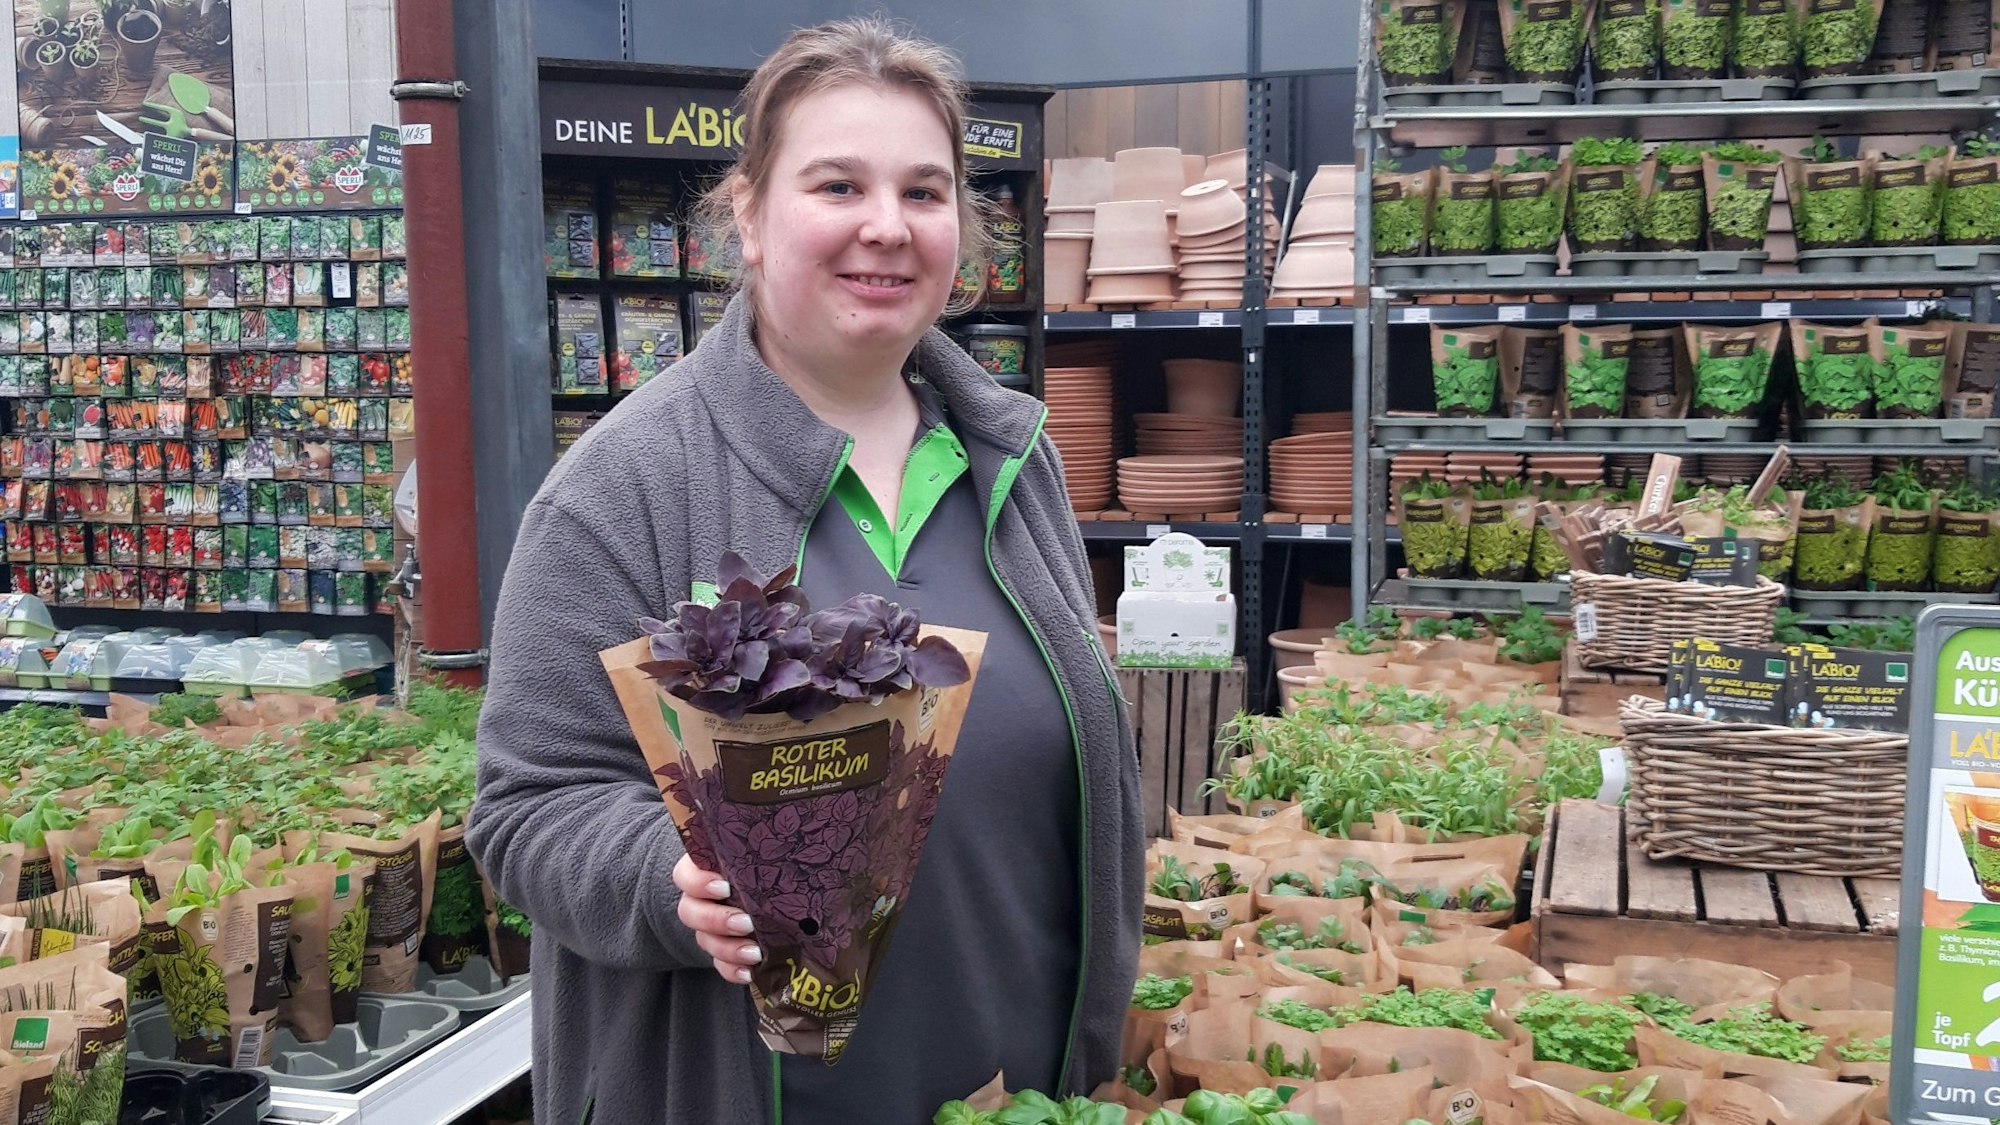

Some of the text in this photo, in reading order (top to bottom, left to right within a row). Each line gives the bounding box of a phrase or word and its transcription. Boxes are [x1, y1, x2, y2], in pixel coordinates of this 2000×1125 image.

[556, 119, 633, 144] DEINE
[970, 123, 1015, 139] FÜR EINE
[152, 140, 181, 153] SPERLI
[983, 136, 1016, 149] ERNTE
[150, 152, 187, 167] wächst Dir
[376, 154, 390, 163] ans
[151, 162, 184, 175] ans Herz!
[337, 174, 361, 184] SPERLI
[115, 181, 139, 193] SPERLI
[1132, 637, 1156, 647] Open
[1954, 678, 2000, 707] Kü
[1951, 728, 2000, 760] LA'B
[771, 738, 847, 766] ROTER
[750, 753, 869, 790] BASILIKUM
[1210, 908, 1228, 920] BIO
[203, 921, 216, 929] BIO
[1939, 953, 1985, 966] Basilikum,
[795, 1003, 825, 1018] VOLLER
[1935, 1012, 1952, 1029] je
[13, 1040, 45, 1050] Bioland
[1932, 1030, 1971, 1049] Topf
[1921, 1079, 1976, 1104] Zum
[1452, 1097, 1474, 1112] BiO
